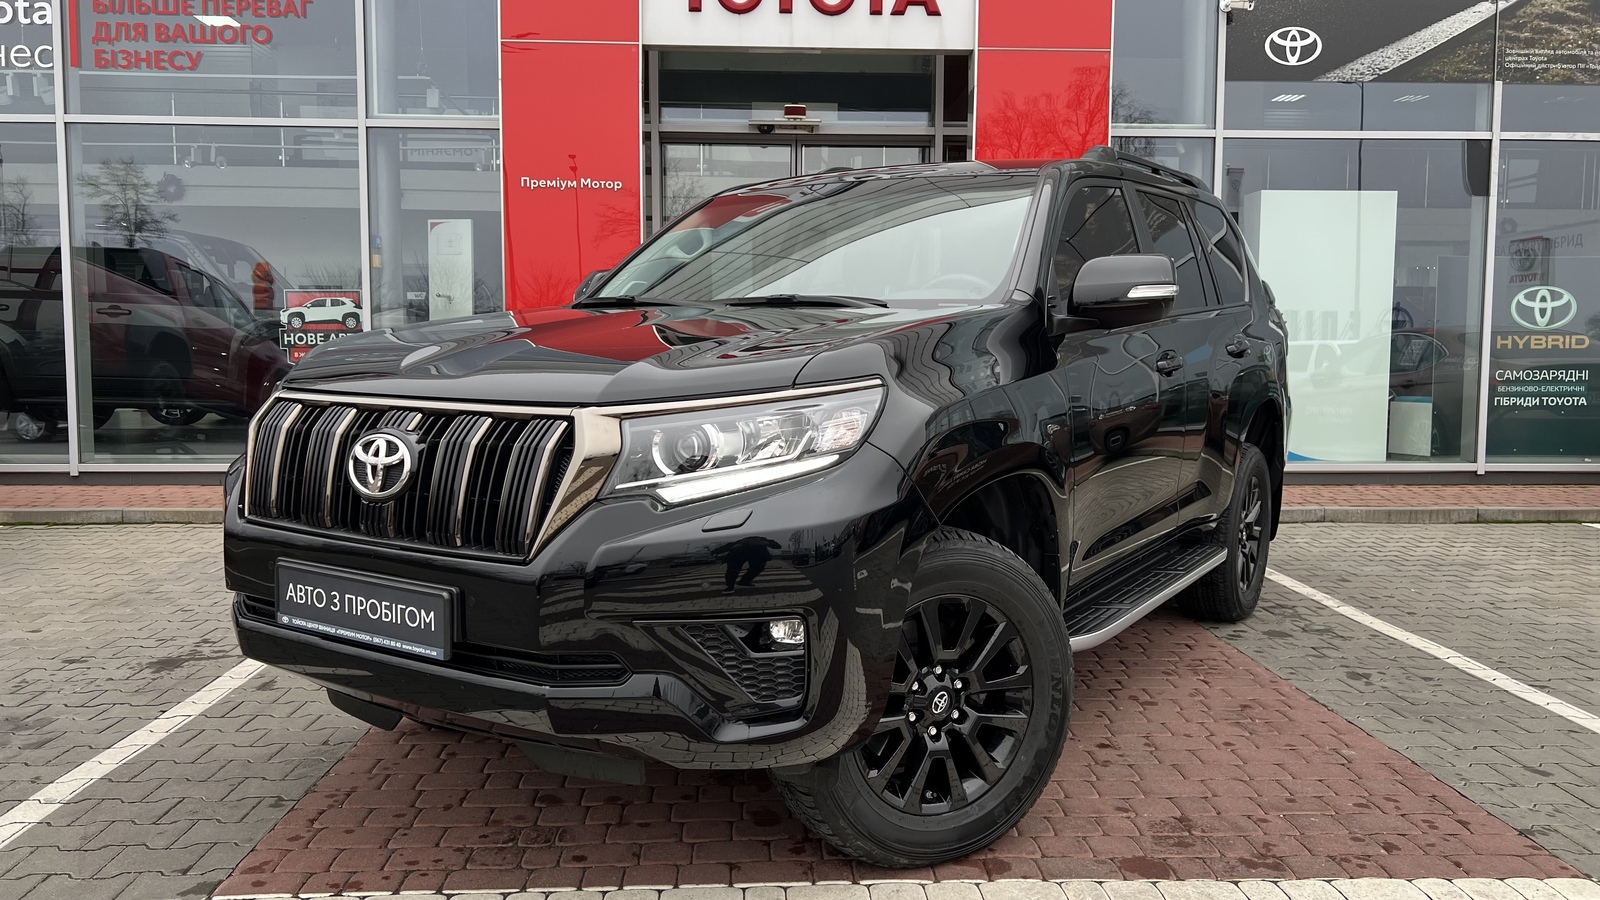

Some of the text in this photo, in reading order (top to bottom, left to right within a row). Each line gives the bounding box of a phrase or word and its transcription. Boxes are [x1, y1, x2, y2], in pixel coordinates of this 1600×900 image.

[92, 0, 313, 18] БІЛЬШЕ ПЕРЕВАГ
[92, 21, 273, 45] ДЛЯ ВАШОГО
[94, 48, 202, 71] БІЗНЕСУ
[521, 176, 623, 191] Преміум Мотор
[284, 333, 324, 345] НОВЕ
[1496, 334, 1590, 350] HYBRID
[1495, 369, 1589, 382] САМОЗАРЯДНІ
[1497, 385, 1585, 393] БЕНЗИНОВО-ЕЛЕКТРИЧНІ
[1494, 396, 1588, 408] ГІБРИДИ TOYOTA
[285, 582, 435, 632] АВТО З ПРОБІГОМ
